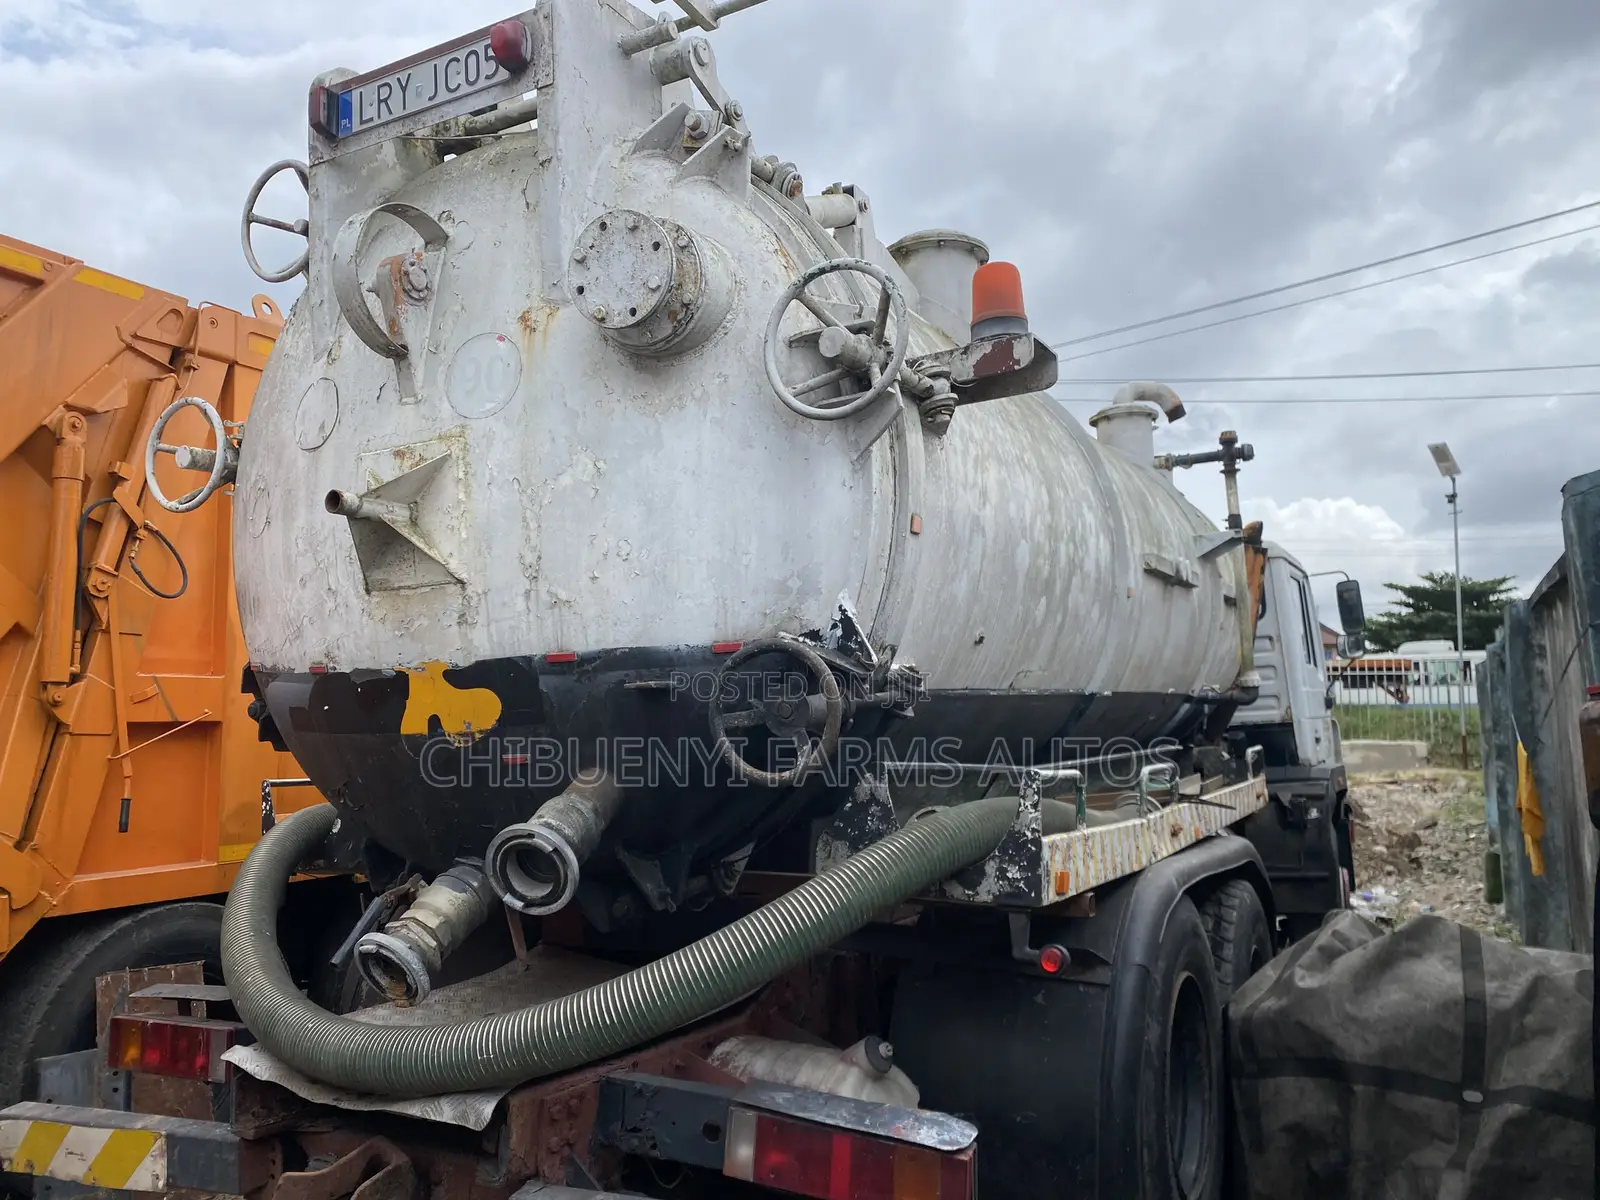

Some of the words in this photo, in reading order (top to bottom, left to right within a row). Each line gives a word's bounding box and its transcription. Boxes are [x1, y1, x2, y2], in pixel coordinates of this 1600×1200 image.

[359, 73, 411, 126] LRY
[428, 43, 500, 101] JC05
[341, 119, 351, 129] PL
